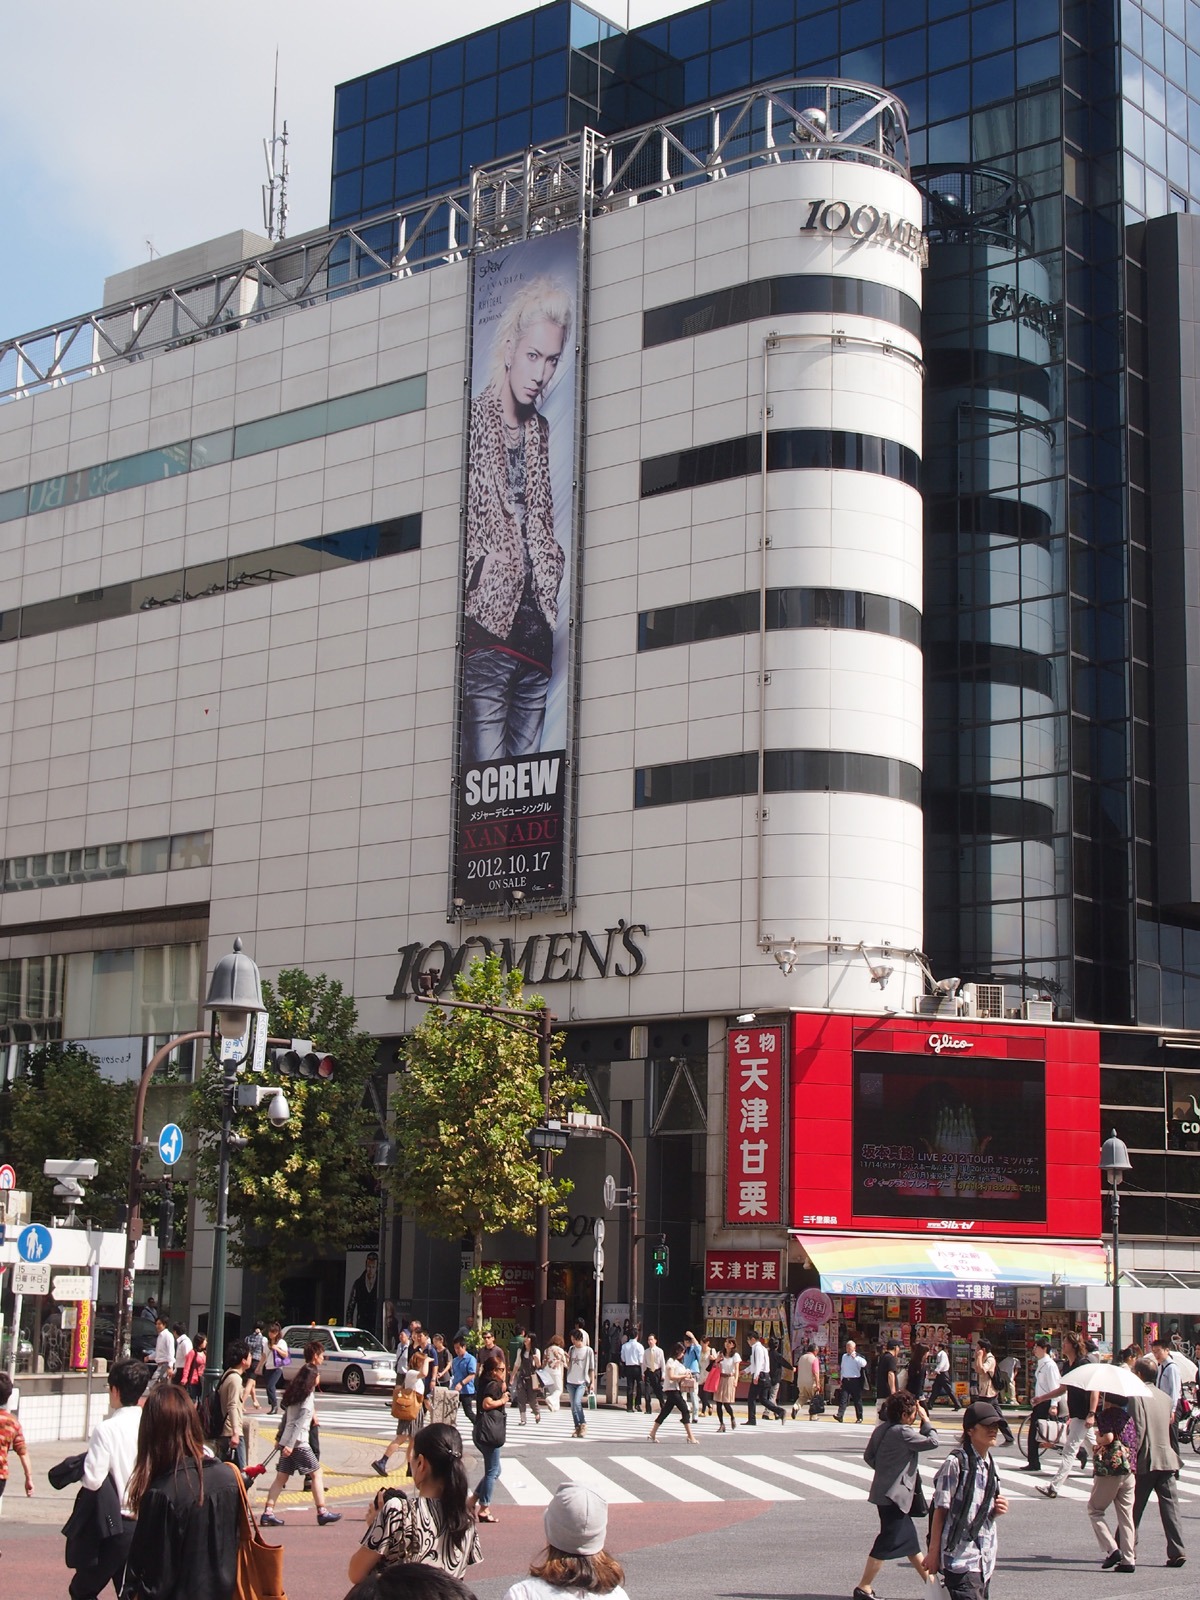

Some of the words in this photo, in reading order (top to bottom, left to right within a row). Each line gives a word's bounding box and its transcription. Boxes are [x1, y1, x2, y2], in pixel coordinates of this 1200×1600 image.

[465, 758, 560, 806] SCREW
[470, 802, 552, 821] メジャーデビューシングル
[464, 819, 558, 849] XANADU
[467, 852, 551, 879] 2012.10.17
[489, 880, 501, 890] ON
[502, 876, 527, 889] SALE
[734, 1033, 776, 1053] 名物
[928, 1034, 974, 1053] Glico
[738, 1058, 769, 1216] 天津甘栗
[918, 1153, 938, 1161] LIVE
[942, 1153, 965, 1162] 2012
[968, 1155, 994, 1164] TOUR
[802, 1214, 838, 1224] 三千里薬品
[18, 1265, 26, 1273] 15
[41, 1266, 47, 1274] 5
[504, 1269, 535, 1280] OPEN
[709, 1261, 776, 1280] 天津甘栗
[40, 1284, 45, 1292] 5
[845, 1279, 920, 1296] SANZENRI
[804, 1298, 827, 1313] 韓国
[914, 1298, 922, 1323] クスリ
